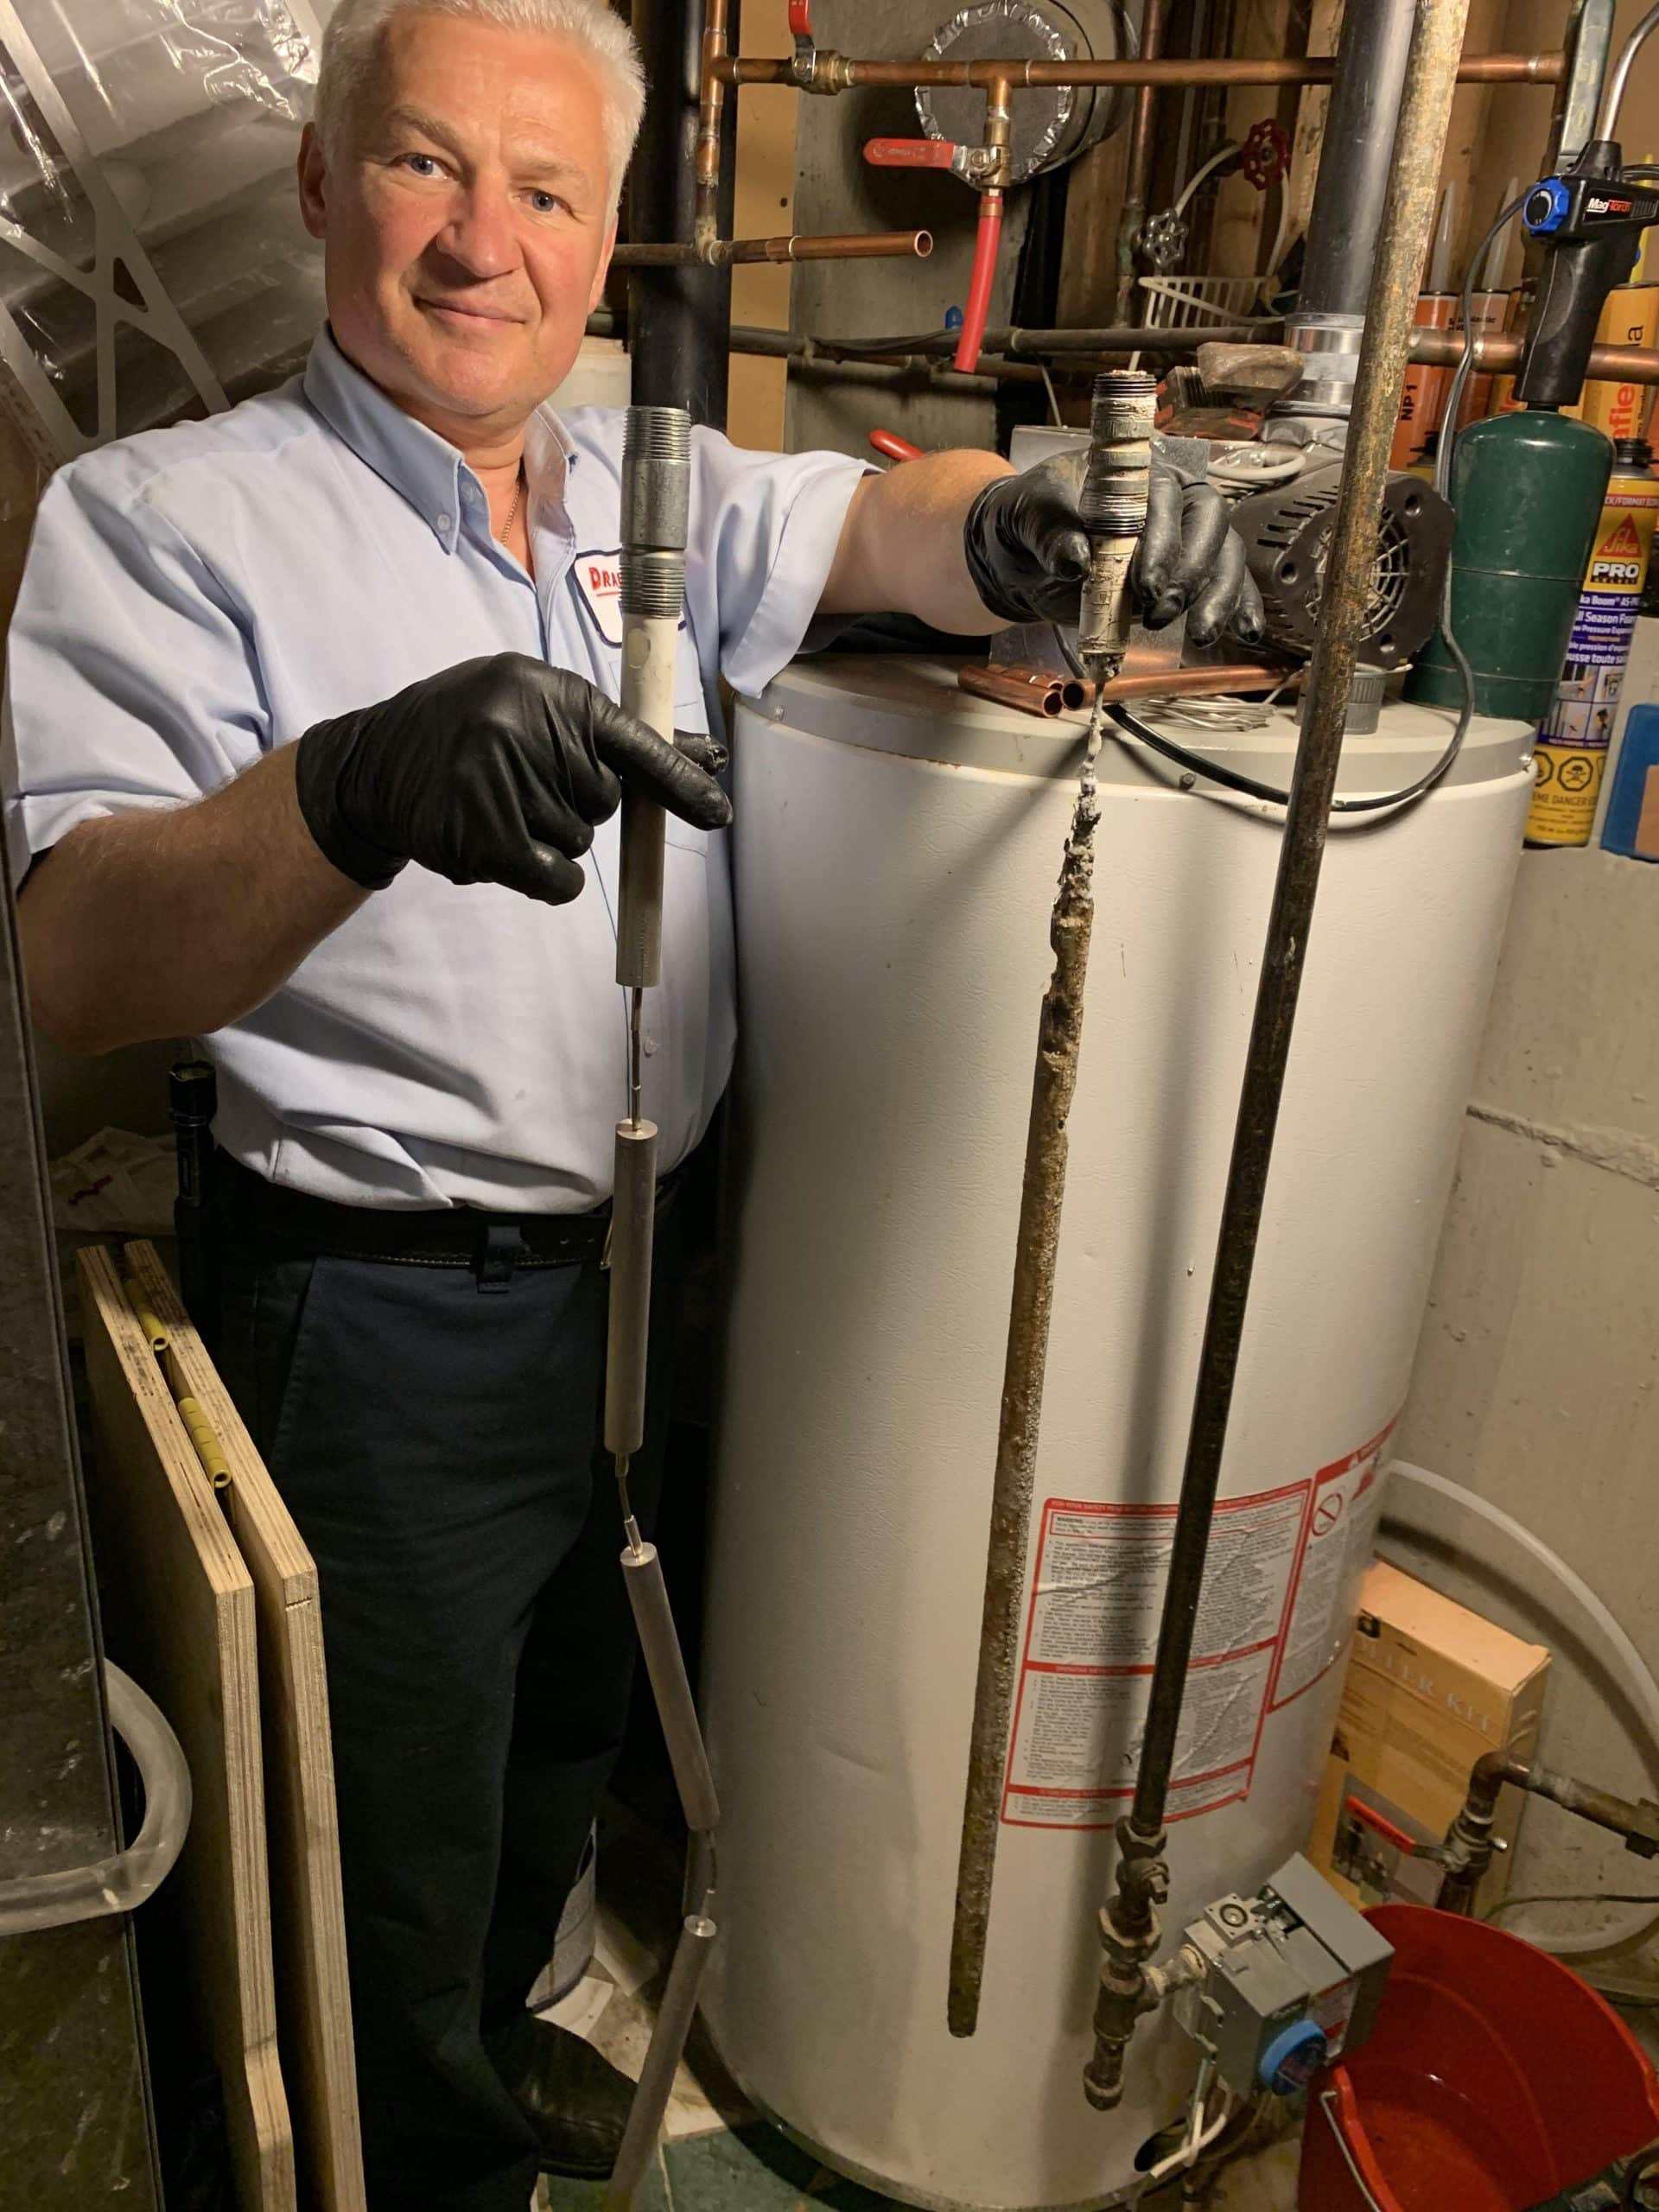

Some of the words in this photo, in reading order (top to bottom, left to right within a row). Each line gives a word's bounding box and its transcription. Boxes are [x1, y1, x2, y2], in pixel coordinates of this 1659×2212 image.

[1592, 562, 1639, 578] PRO
[1580, 594, 1591, 604] ka
[1584, 611, 1618, 624] Season
[1592, 653, 1615, 664] toute
